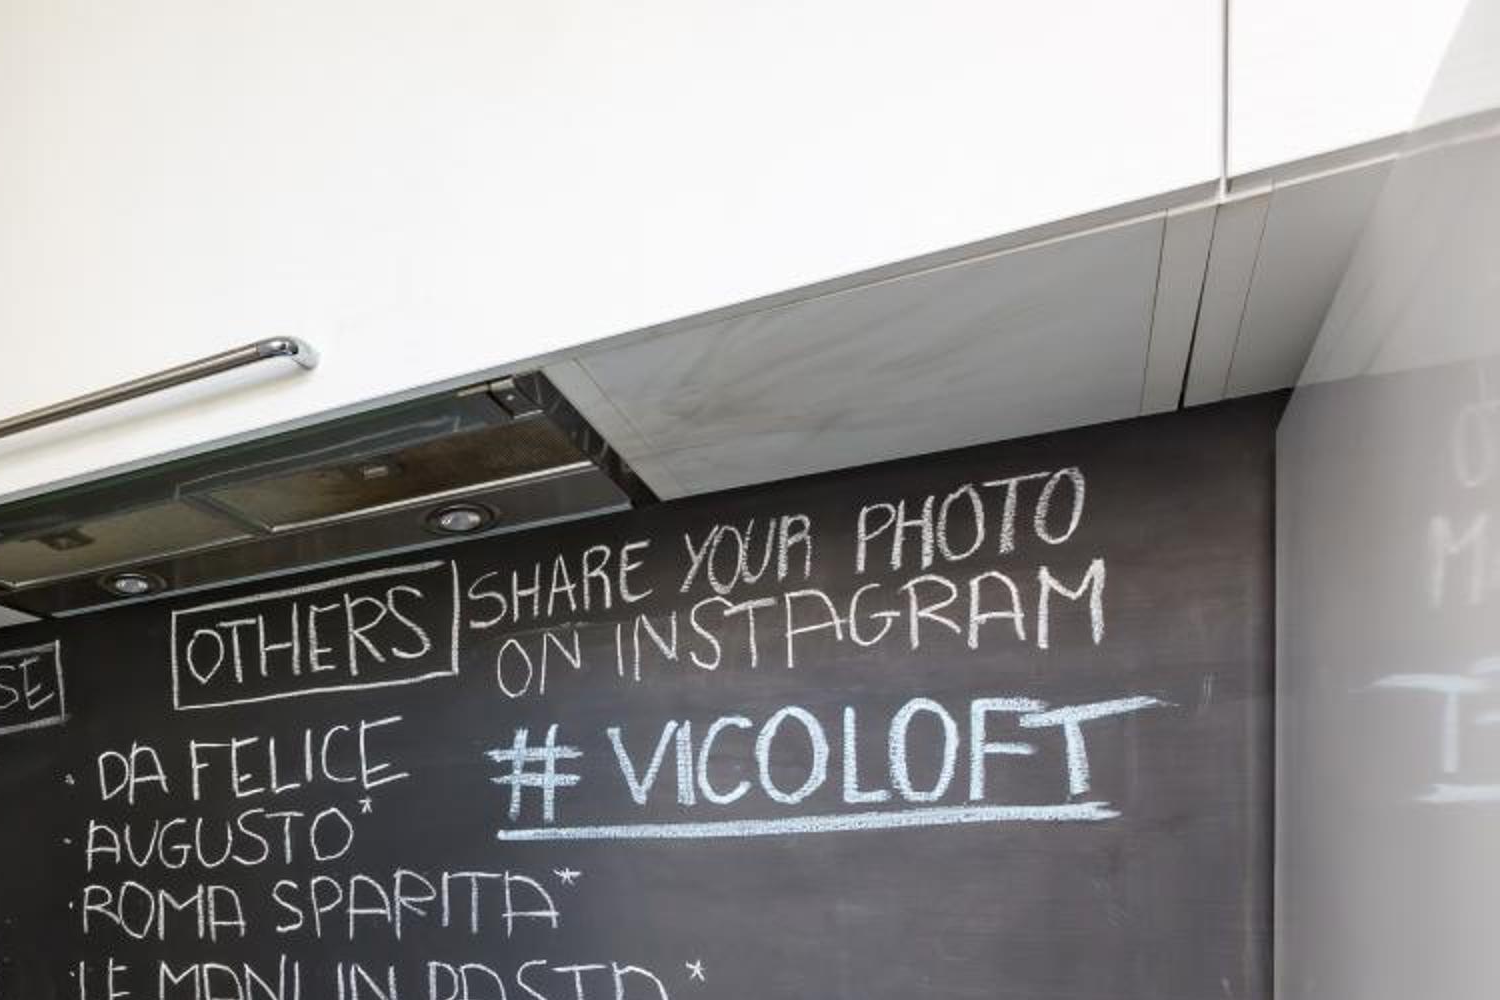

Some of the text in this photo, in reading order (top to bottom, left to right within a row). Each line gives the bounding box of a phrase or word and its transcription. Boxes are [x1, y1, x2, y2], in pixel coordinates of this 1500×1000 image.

[467, 466, 1086, 629] SHARE YOUR PHOTO
[187, 585, 432, 684] OTHERS
[497, 559, 1106, 698] ON INSTAGRAM
[99, 717, 409, 805] DA FELICE
[85, 808, 354, 871] AUGUSTO
[83, 870, 560, 940] ROMA SPARITA
